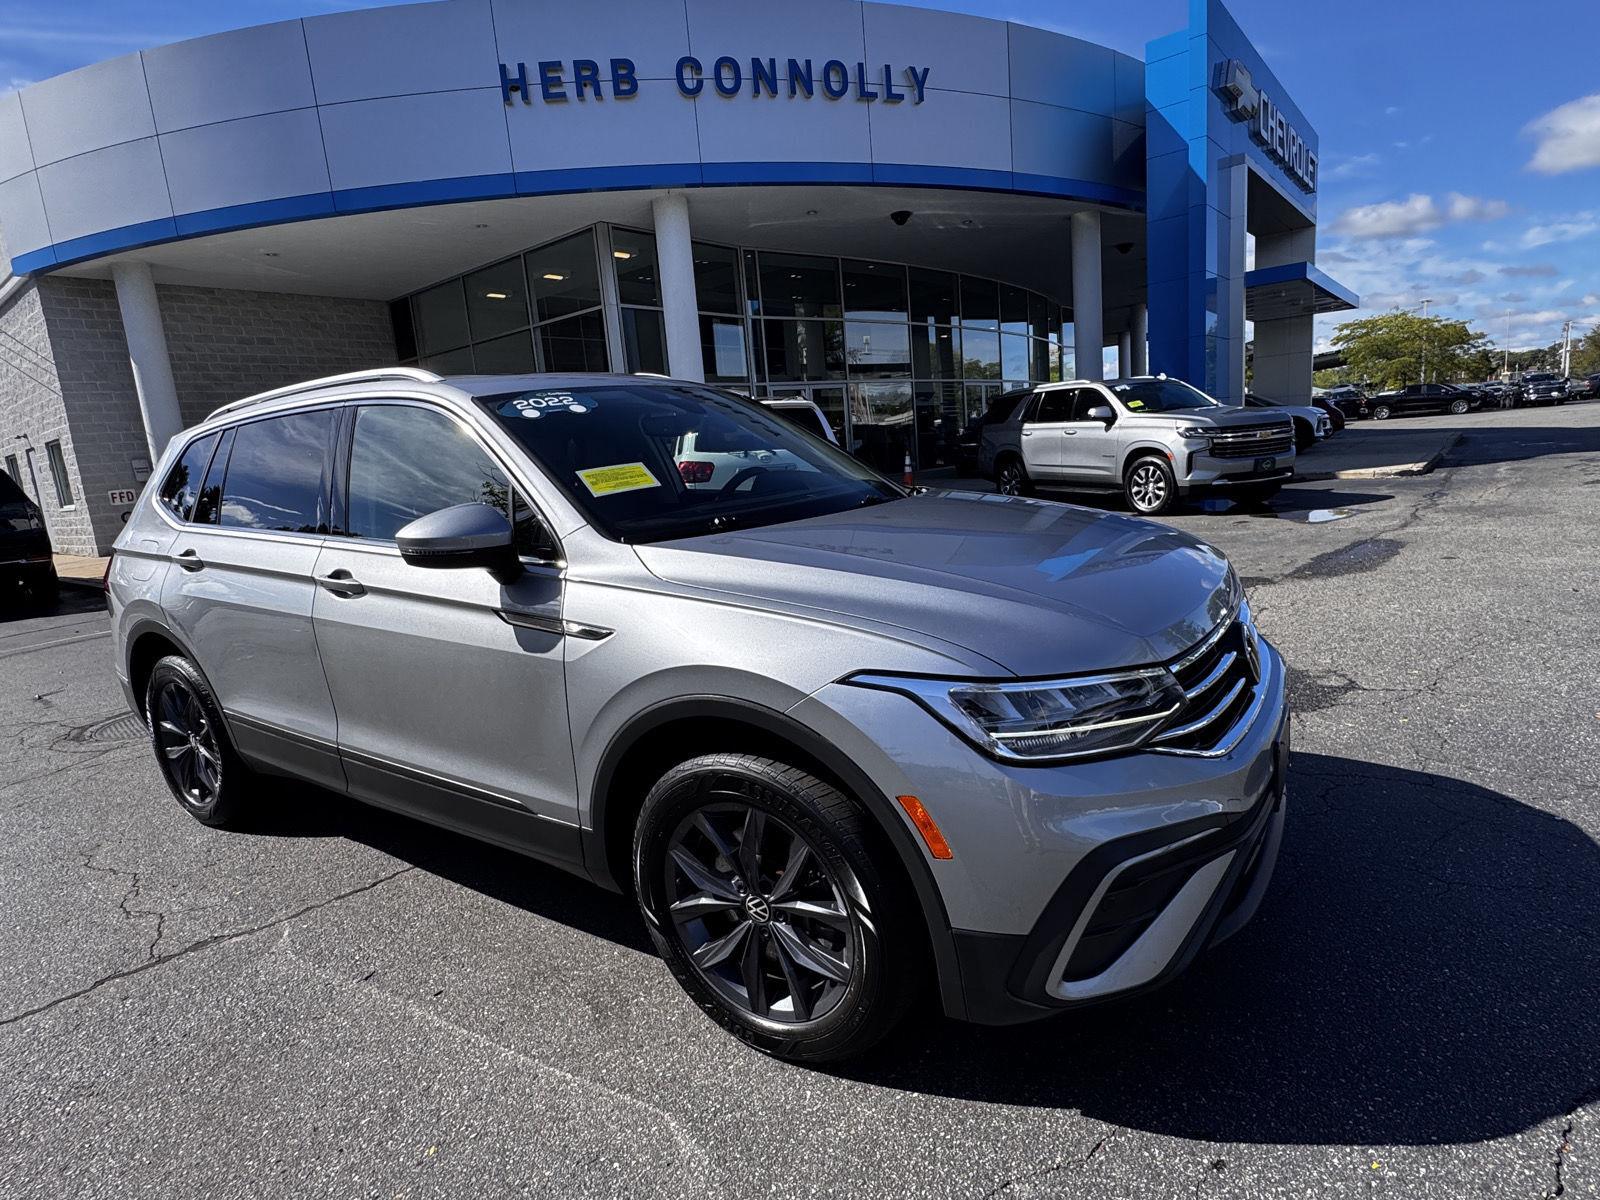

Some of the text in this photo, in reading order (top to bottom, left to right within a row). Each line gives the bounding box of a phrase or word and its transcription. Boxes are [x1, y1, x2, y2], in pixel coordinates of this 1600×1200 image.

[499, 56, 930, 104] HERB CONNOLLY
[1260, 89, 1318, 192] CHEVROLET
[512, 396, 578, 410] 2022
[110, 491, 135, 503] FFD
